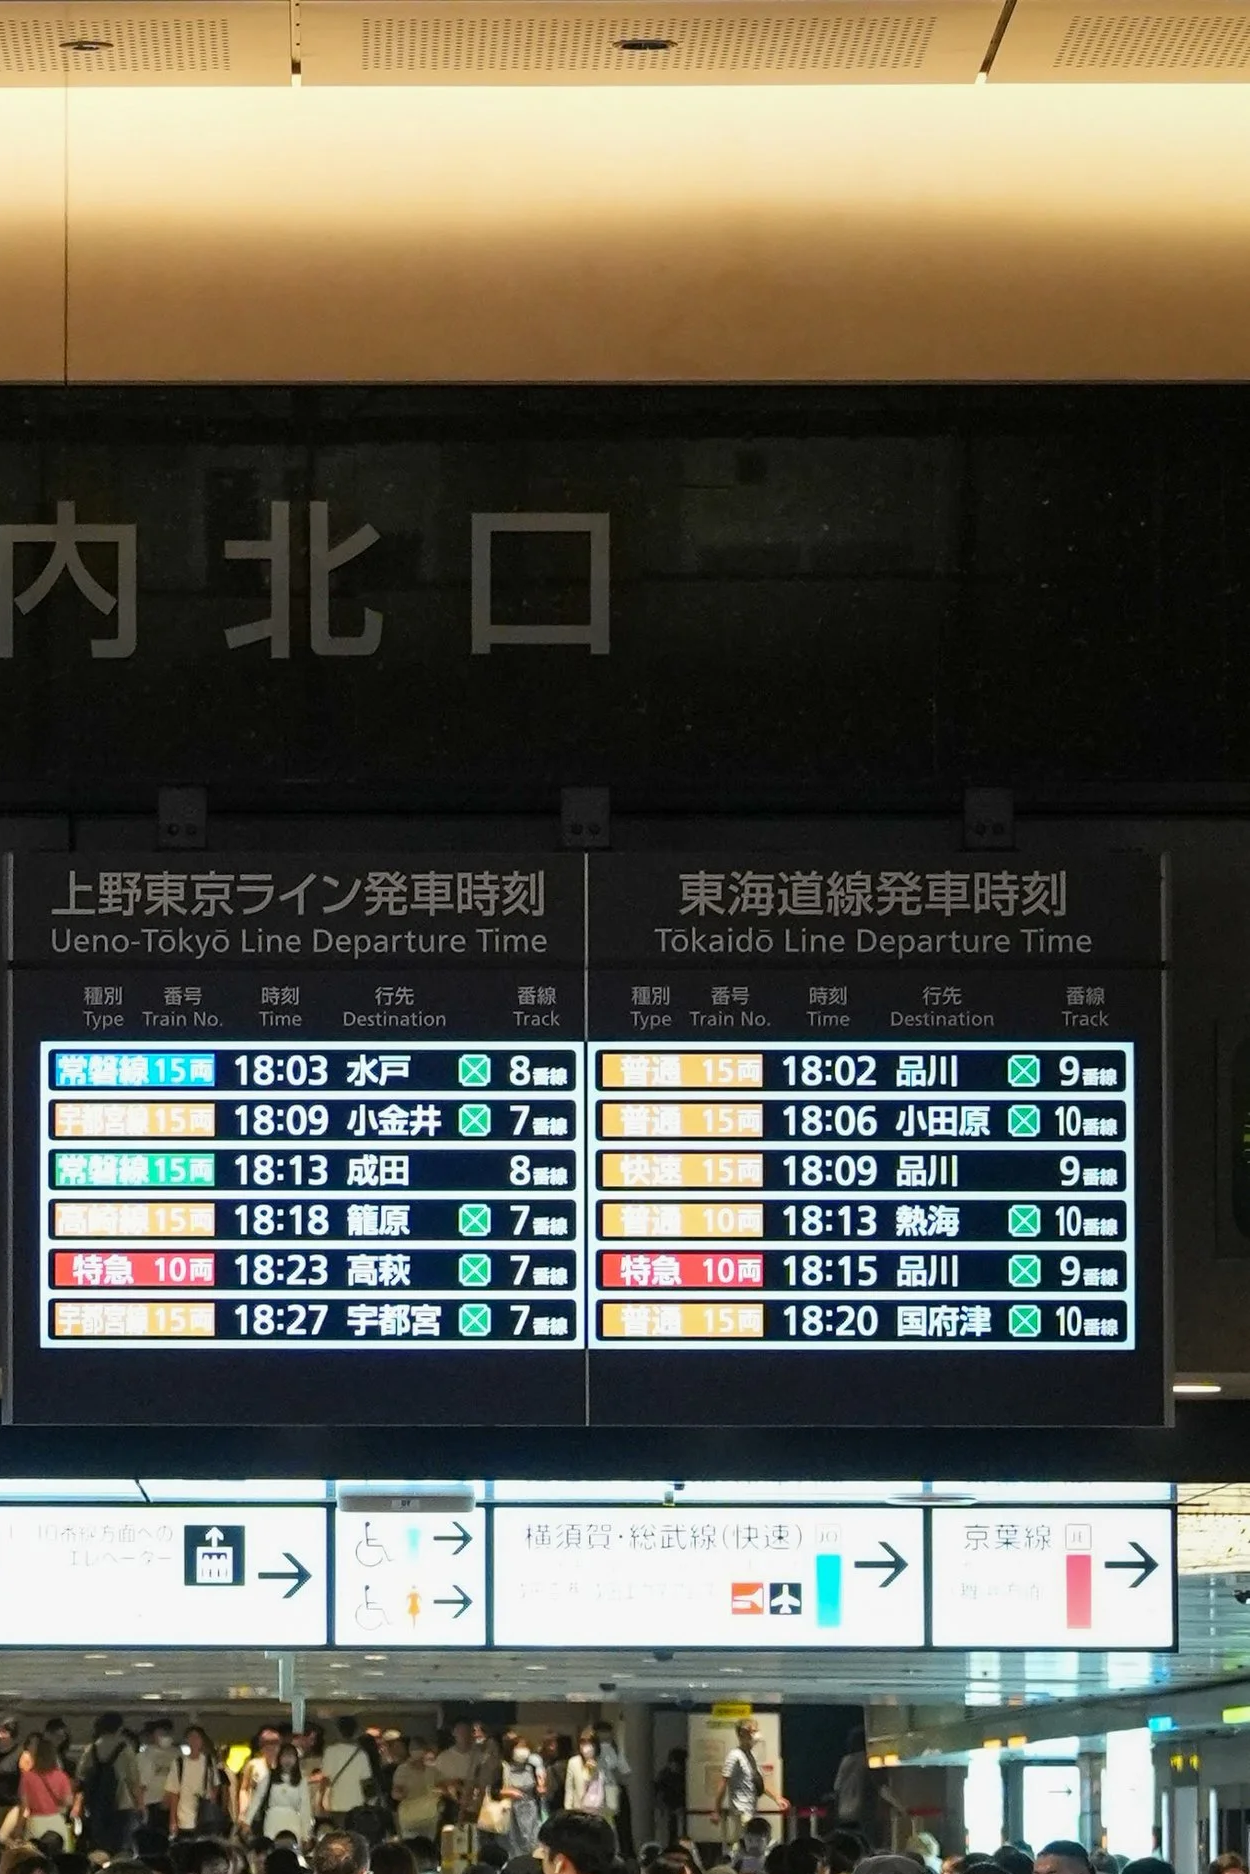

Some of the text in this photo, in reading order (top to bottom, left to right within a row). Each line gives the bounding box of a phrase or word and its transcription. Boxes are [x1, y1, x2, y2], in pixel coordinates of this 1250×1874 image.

[51, 870, 545, 918] 上野東京ライン発車時刻
[678, 870, 1067, 918] 東海道線発車時刻
[242, 928, 301, 952] Line
[314, 929, 465, 959] Departure
[476, 928, 547, 952] Time
[786, 928, 845, 952] Line
[858, 929, 1010, 959] Departure
[1020, 928, 1091, 952] Time
[84, 987, 122, 1005] 種別
[164, 987, 202, 1005] 番号
[262, 987, 299, 1005] 時刻
[375, 987, 414, 1005] 行先
[518, 987, 556, 1005] 番線
[632, 987, 669, 1005] 種別
[712, 987, 749, 1005] 番号
[810, 986, 847, 1005] 時刻
[923, 987, 961, 1005] 行先
[1067, 987, 1104, 1005] 番線
[83, 1011, 123, 1030] Type
[142, 1012, 222, 1026] Train No.
[259, 1011, 302, 1026] Time
[344, 1011, 446, 1026] Destination
[513, 1011, 560, 1026] Track
[630, 1011, 671, 1030] Type
[690, 1011, 770, 1026] Train No.
[807, 1011, 850, 1026] Time
[891, 1011, 994, 1026] Destination
[1062, 1011, 1109, 1026] Track
[235, 1055, 327, 1085] 18:03
[347, 1054, 411, 1086] 水戸
[783, 1055, 876, 1086] 18:02
[896, 1055, 957, 1087] 品川
[235, 1105, 328, 1135] 18:09
[347, 1104, 441, 1136] 小金井
[783, 1105, 877, 1136] 18:06
[896, 1105, 990, 1136] 小田原
[235, 1155, 327, 1185] 18:13
[347, 1154, 409, 1186] 成田
[783, 1155, 877, 1186] 18:09
[897, 1155, 957, 1187] 品川
[235, 1205, 329, 1235] 18:18
[783, 1205, 876, 1236] 18:13
[896, 1205, 959, 1236] 熱海
[72, 1254, 134, 1286] 特急
[235, 1254, 328, 1285] 18:23
[620, 1255, 682, 1286] 特急
[784, 1255, 877, 1286] 18:15
[897, 1255, 958, 1287] 品川
[235, 1304, 328, 1335] 18:27
[347, 1304, 441, 1336] 宇都宮
[784, 1305, 878, 1336] 18:20
[898, 1305, 991, 1336] 国府津
[964, 1524, 1052, 1550] 京葉線
